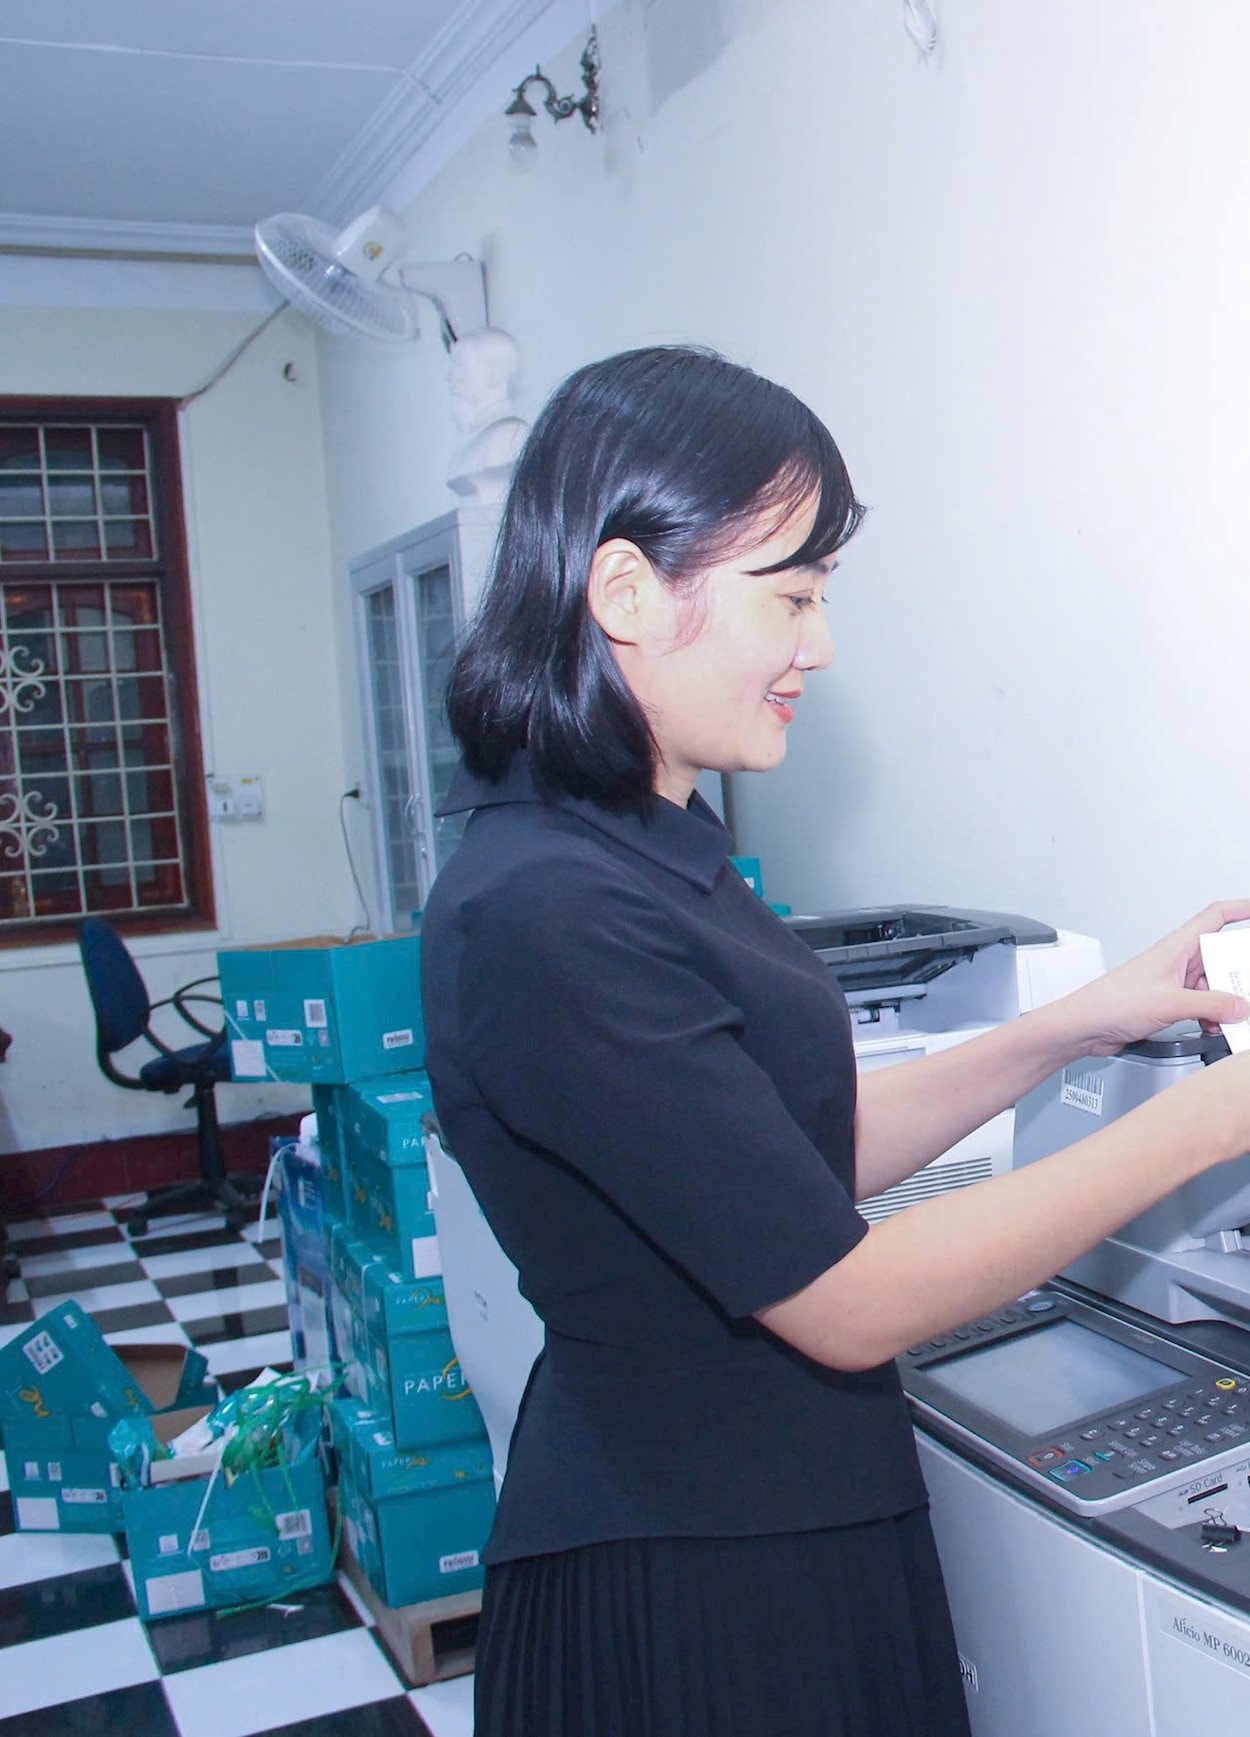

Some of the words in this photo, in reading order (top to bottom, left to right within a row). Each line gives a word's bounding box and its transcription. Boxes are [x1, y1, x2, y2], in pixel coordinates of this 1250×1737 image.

[1189, 1482, 1202, 1494] SD
[1204, 1473, 1223, 1488] Card
[1172, 1616, 1201, 1642] Aficio
[1203, 1631, 1220, 1651] MP
[1223, 1642, 1250, 1668] 6002
